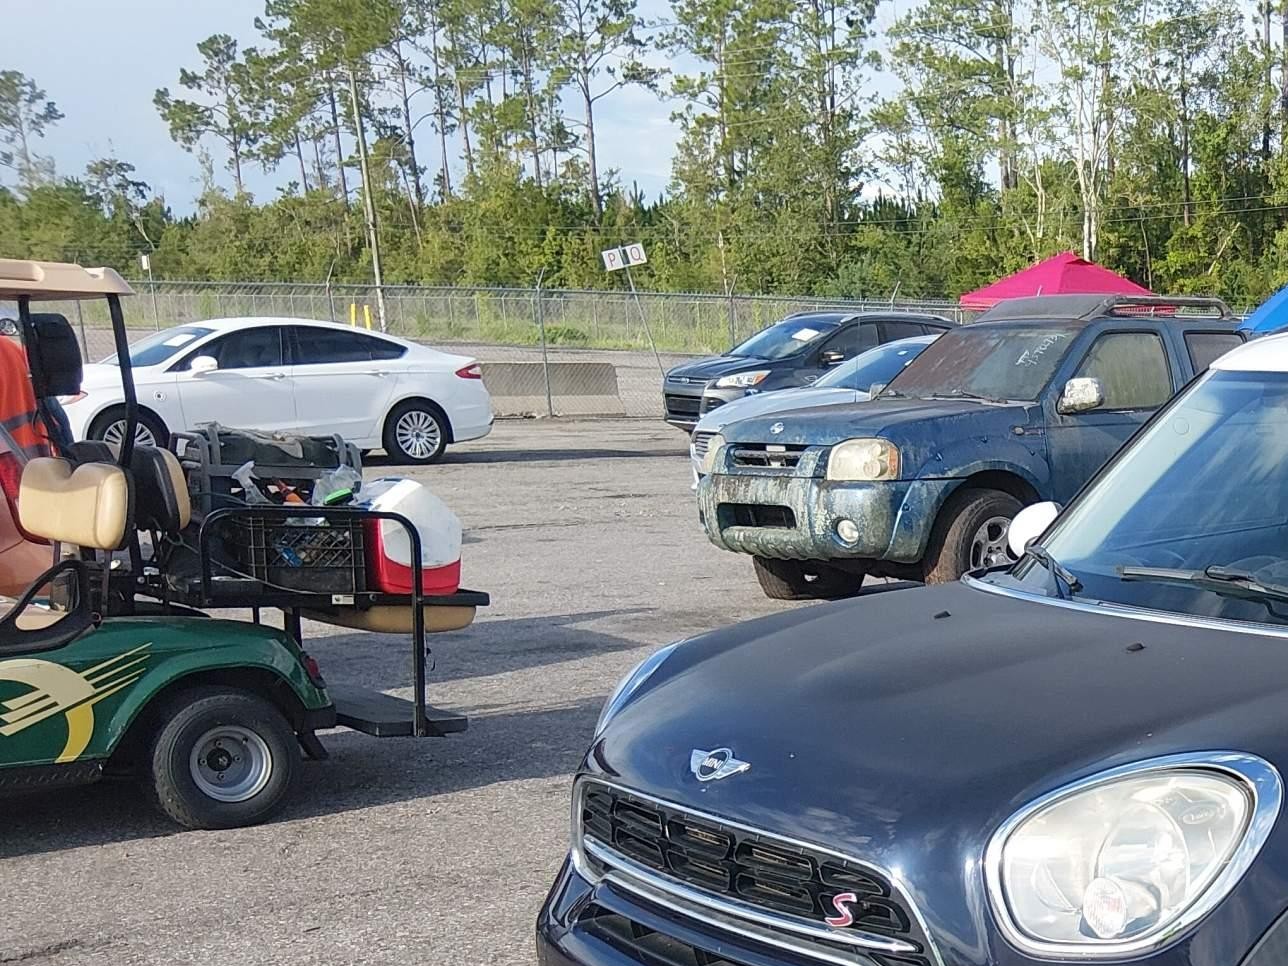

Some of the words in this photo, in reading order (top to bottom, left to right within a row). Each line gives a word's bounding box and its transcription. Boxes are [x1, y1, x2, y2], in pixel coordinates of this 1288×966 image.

[607, 252, 616, 268] P
[630, 246, 645, 262] Q
[702, 756, 724, 771] MINI
[824, 893, 858, 927] S
